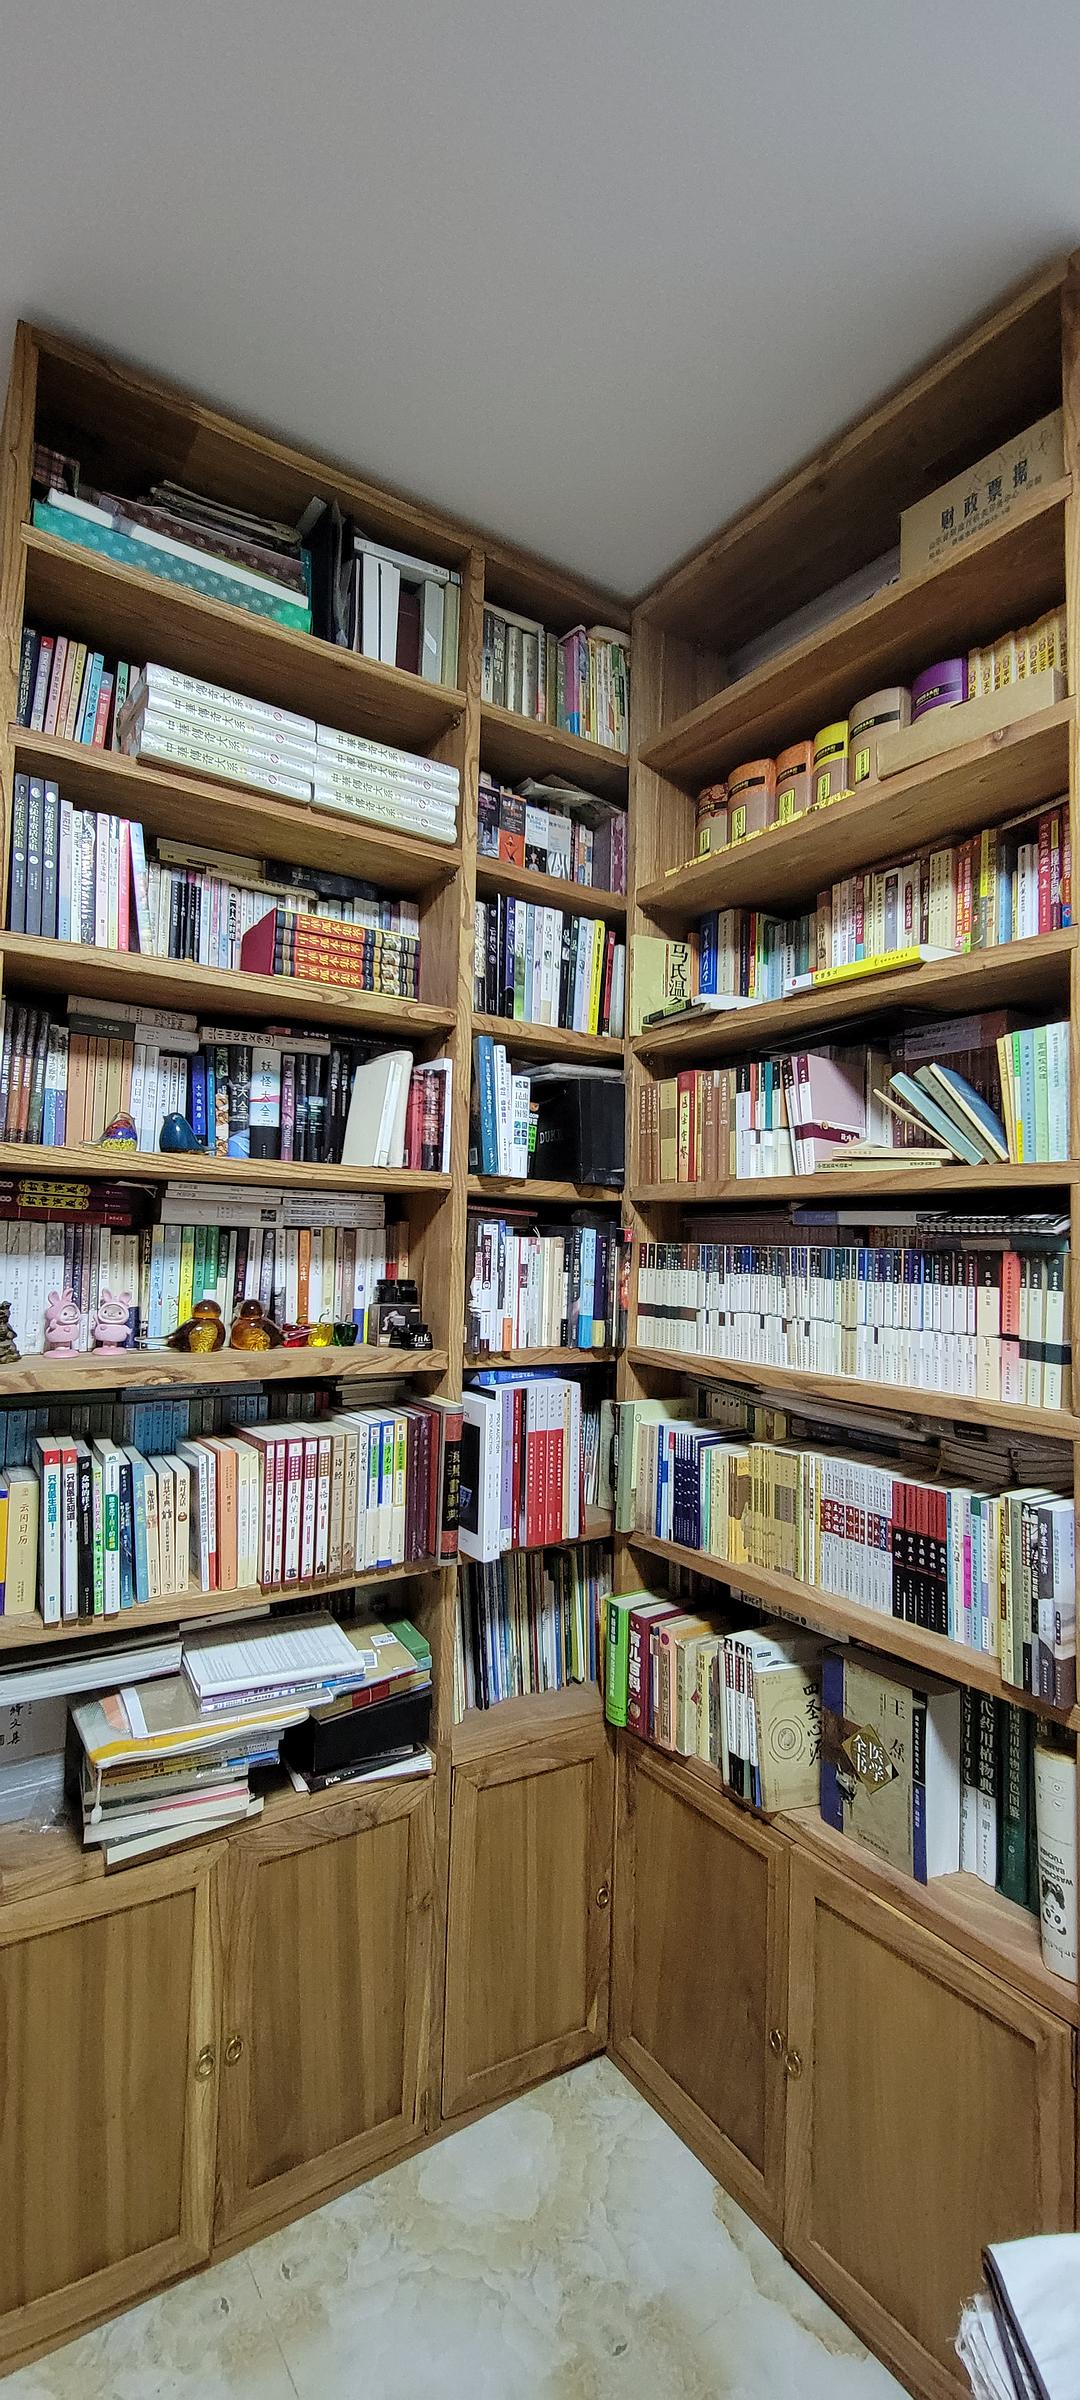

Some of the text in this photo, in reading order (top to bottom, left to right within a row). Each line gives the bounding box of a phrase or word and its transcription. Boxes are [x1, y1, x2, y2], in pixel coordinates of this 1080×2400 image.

[942, 460, 1028, 529] 财政票据
[260, 1061, 272, 1118] 妖怪大全
[979, 1694, 997, 1796] 代药用植物典
